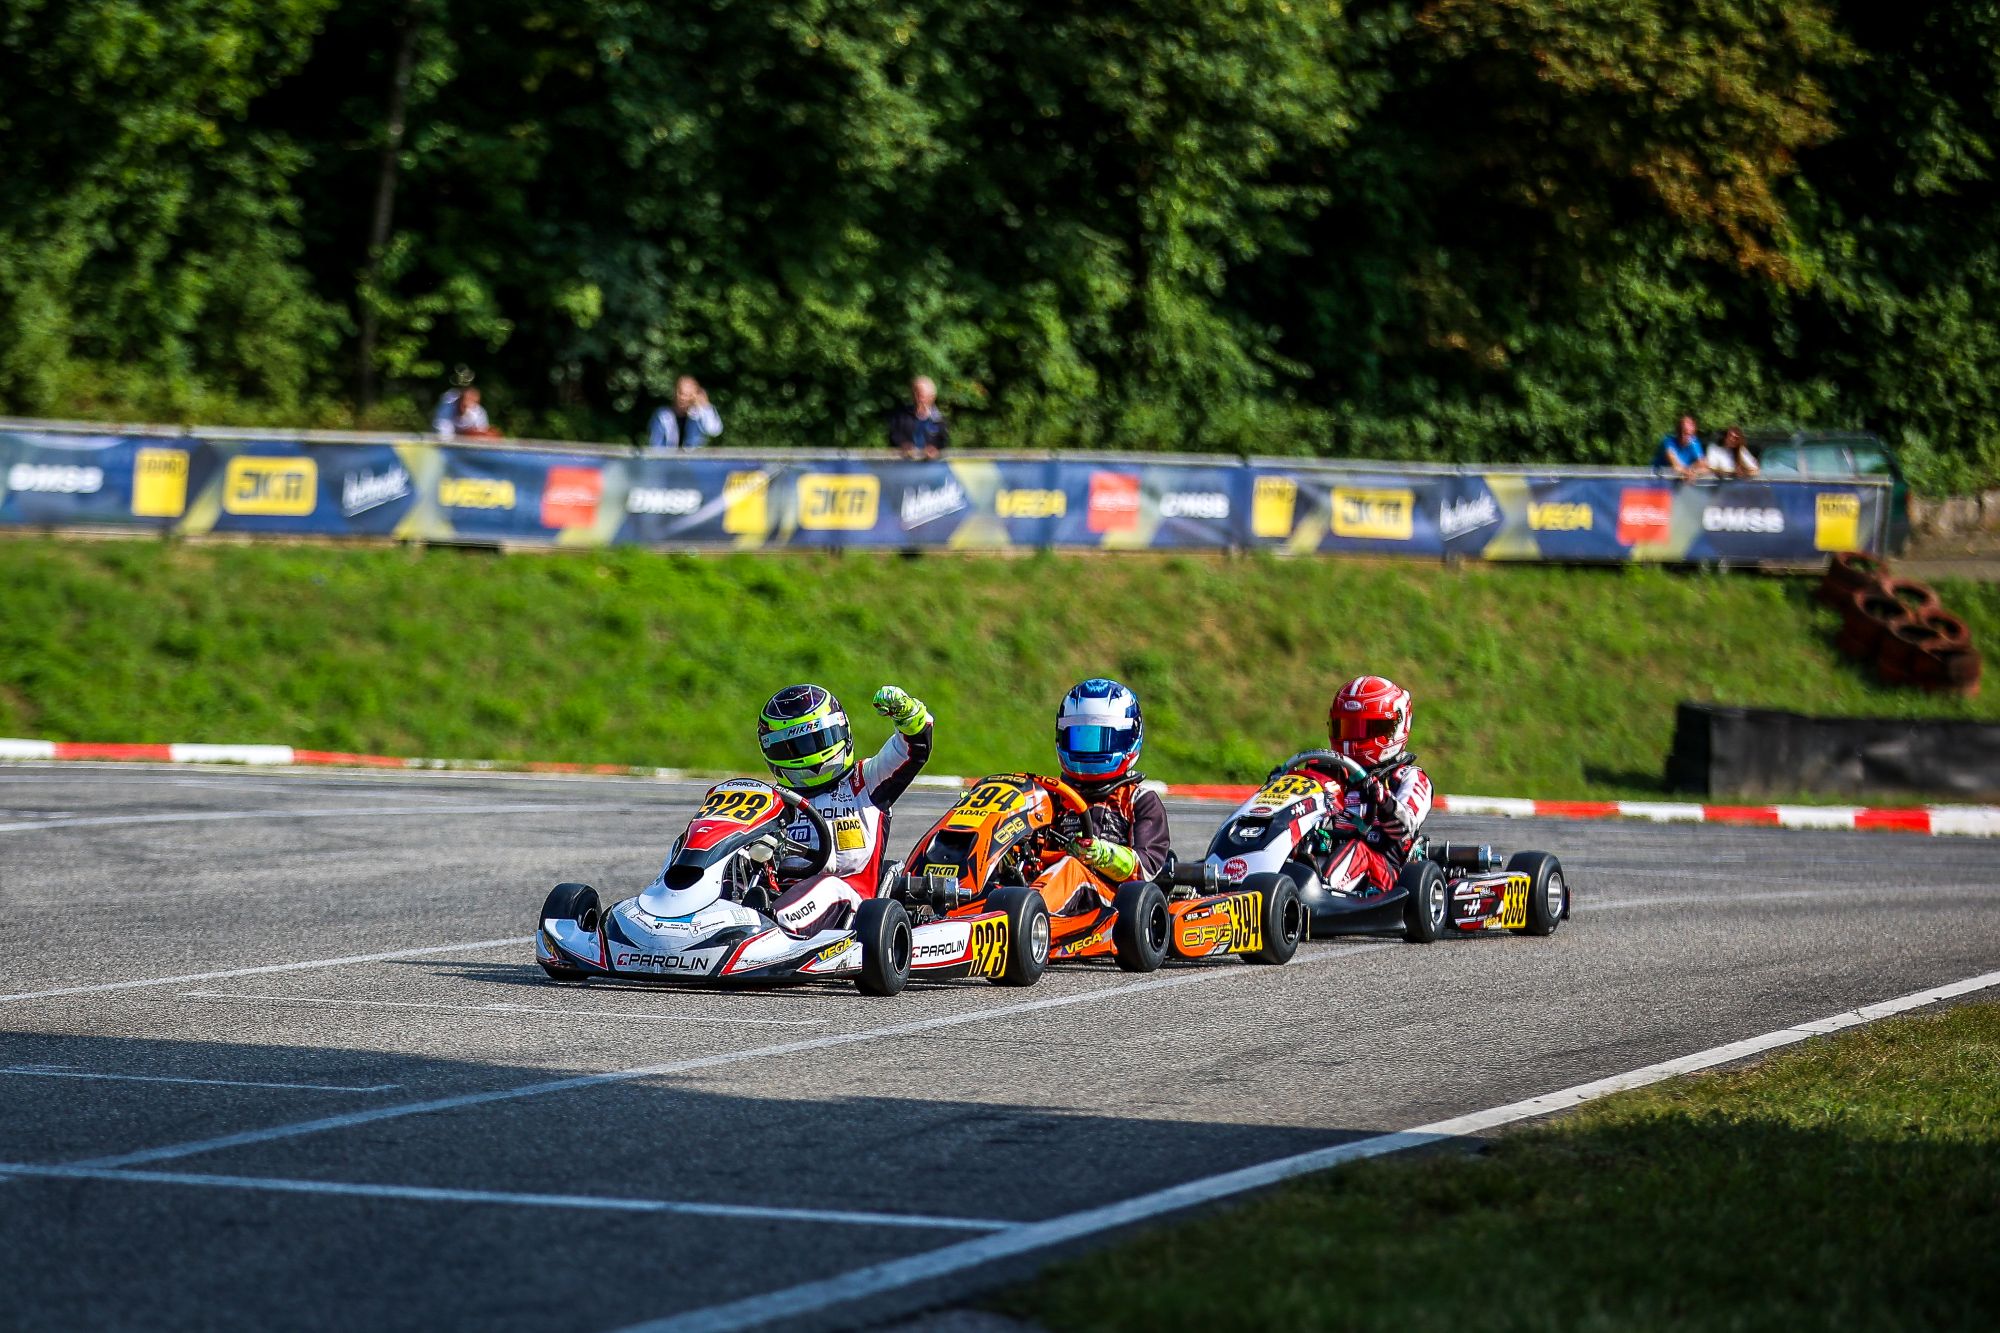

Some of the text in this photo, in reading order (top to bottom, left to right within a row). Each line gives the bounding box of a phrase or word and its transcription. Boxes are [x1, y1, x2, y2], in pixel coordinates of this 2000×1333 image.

[1527, 502, 1593, 531] VEGA
[695, 793, 767, 820] 323
[956, 809, 988, 817] ADAC
[787, 827, 810, 840] KM
[837, 819, 860, 831] ADAC
[994, 817, 1027, 844] CRG
[1212, 901, 1230, 914] VEGA
[1504, 880, 1527, 926] 333
[1233, 894, 1259, 949] 394
[1065, 933, 1102, 953] VEGA
[1183, 925, 1231, 946] CRG
[818, 938, 851, 960] VEGA
[969, 921, 1007, 978] 323
